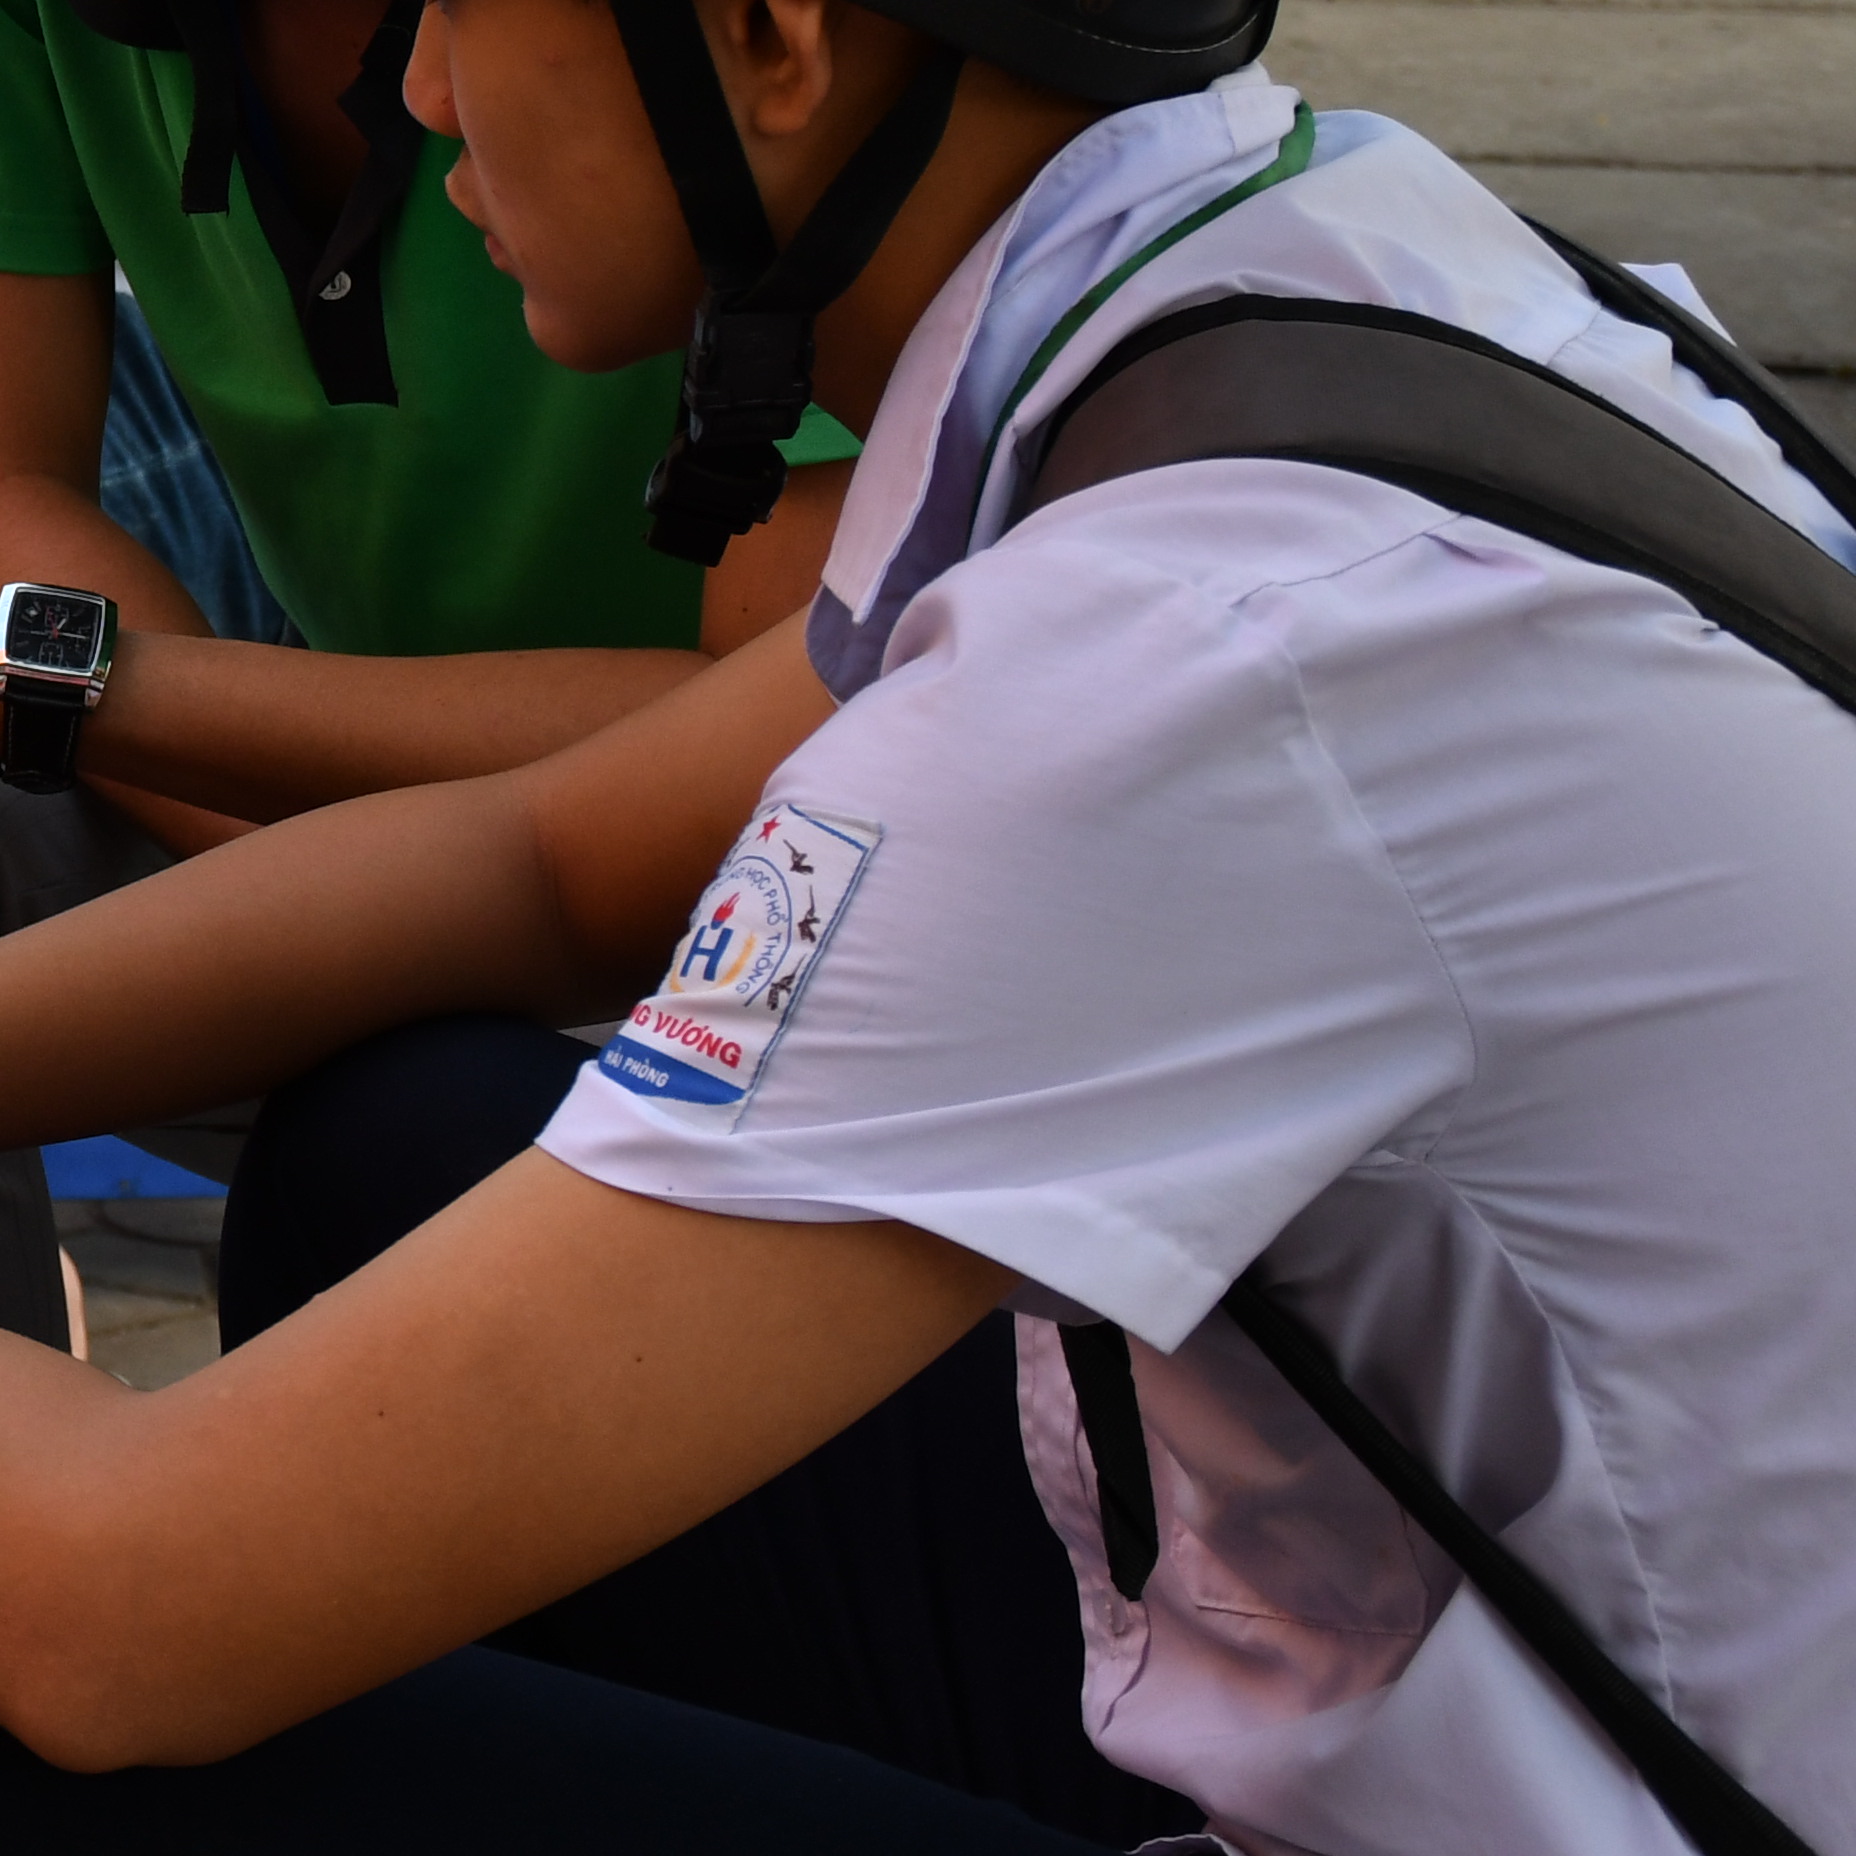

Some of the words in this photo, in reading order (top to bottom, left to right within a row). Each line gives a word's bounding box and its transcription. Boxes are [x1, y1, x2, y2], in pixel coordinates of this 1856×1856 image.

[763, 888, 788, 926] PHỔ
[734, 932, 782, 994] THÔNG
[653, 1011, 742, 1069] VƯƠNG
